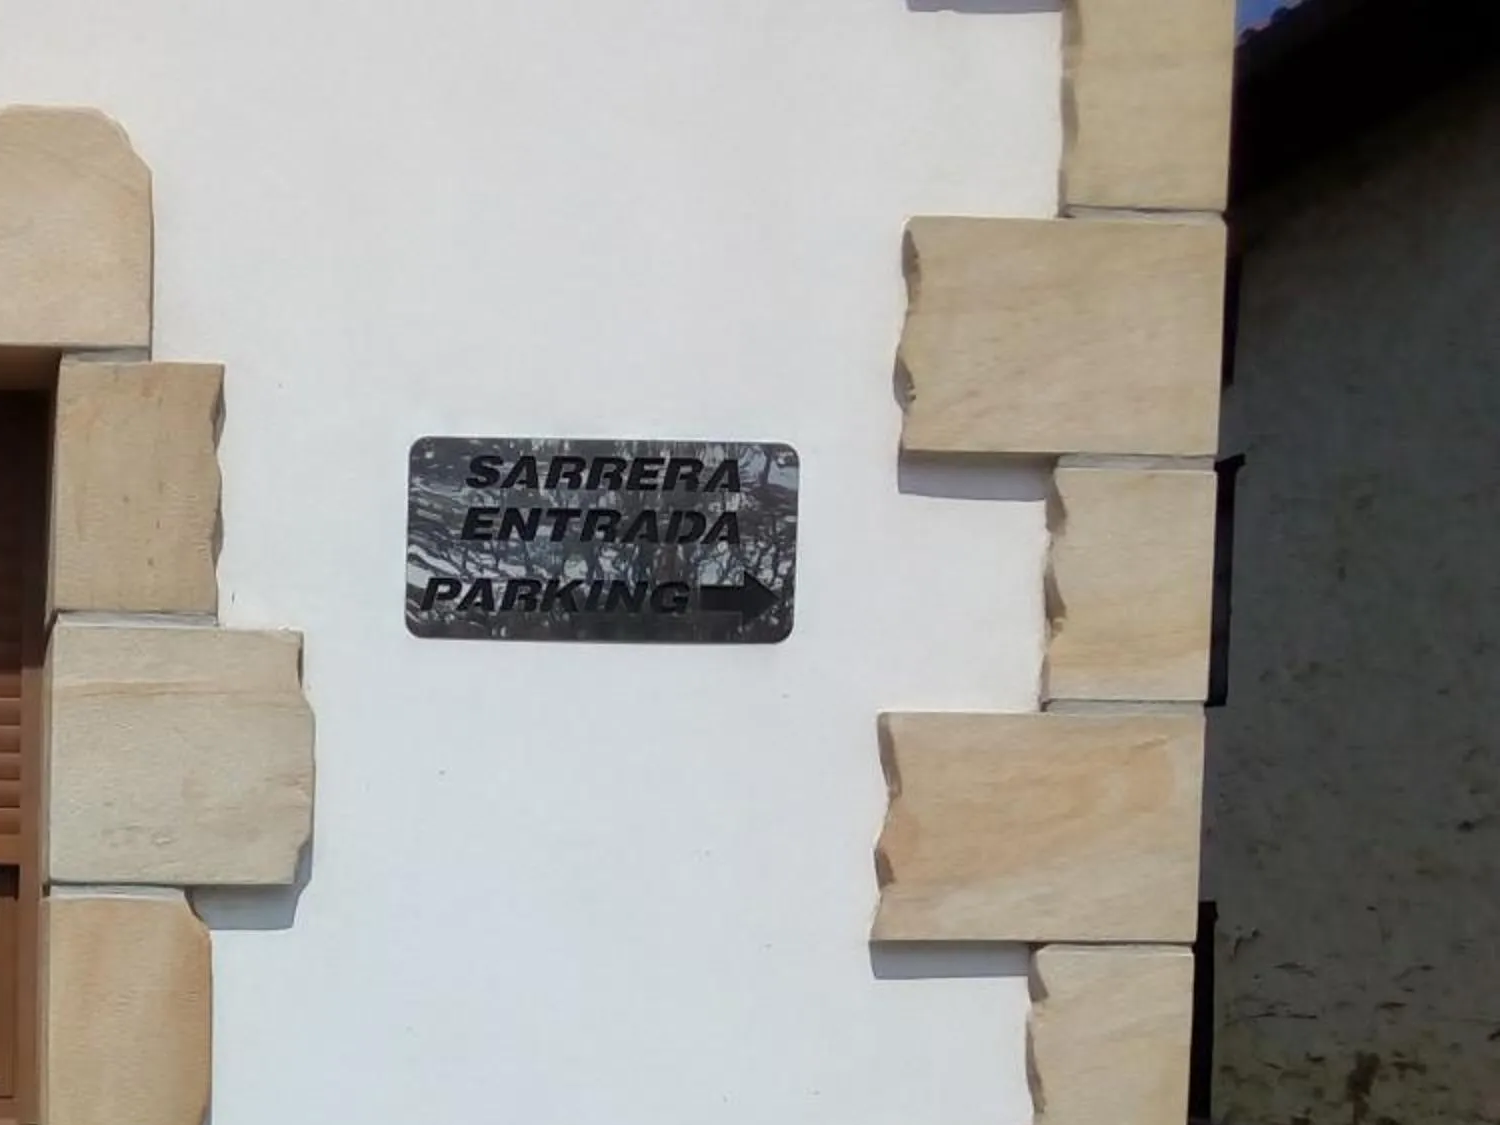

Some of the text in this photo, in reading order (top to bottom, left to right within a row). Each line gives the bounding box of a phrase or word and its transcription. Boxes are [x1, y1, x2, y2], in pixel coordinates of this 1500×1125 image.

[465, 455, 741, 492] SARRERA
[460, 507, 741, 544] ENTRADA
[420, 577, 690, 614] PARKING
